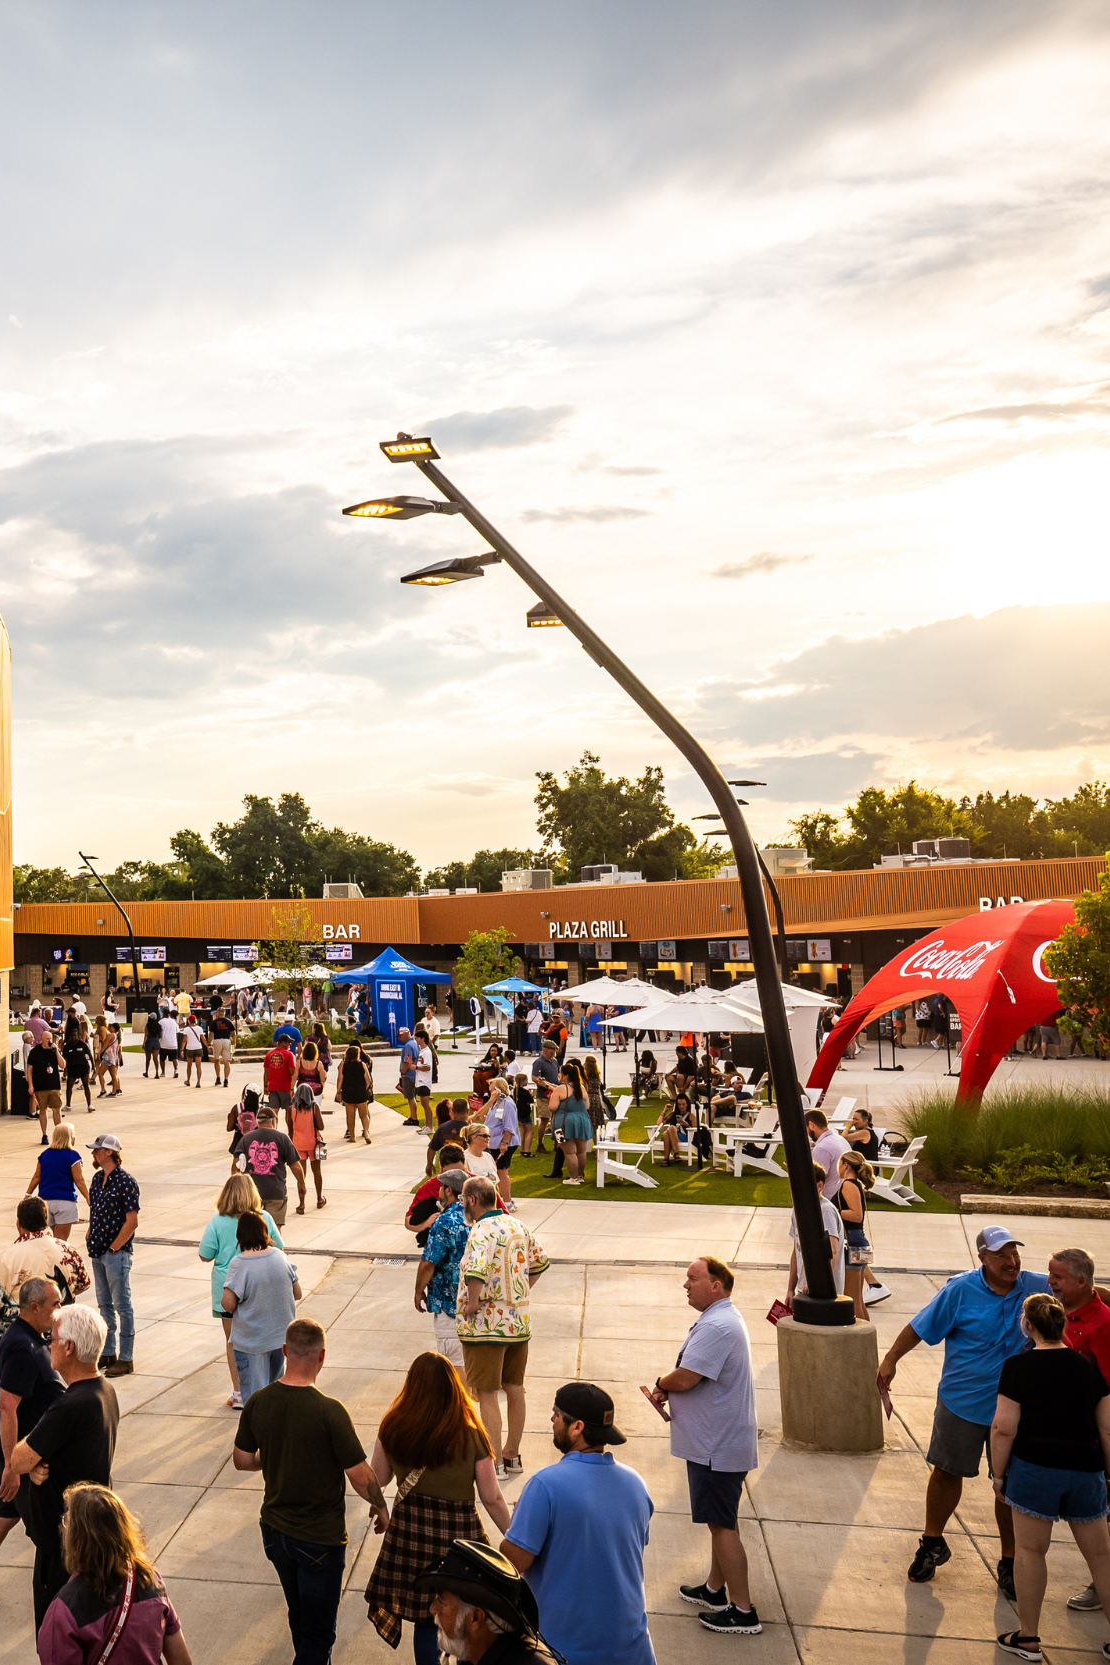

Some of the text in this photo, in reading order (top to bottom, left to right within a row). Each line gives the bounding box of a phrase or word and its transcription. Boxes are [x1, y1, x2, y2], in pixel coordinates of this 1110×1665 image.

[322, 924, 361, 939] BAR
[549, 920, 628, 939] PLAZA GRILL
[899, 939, 1006, 980] Coca-Cola
